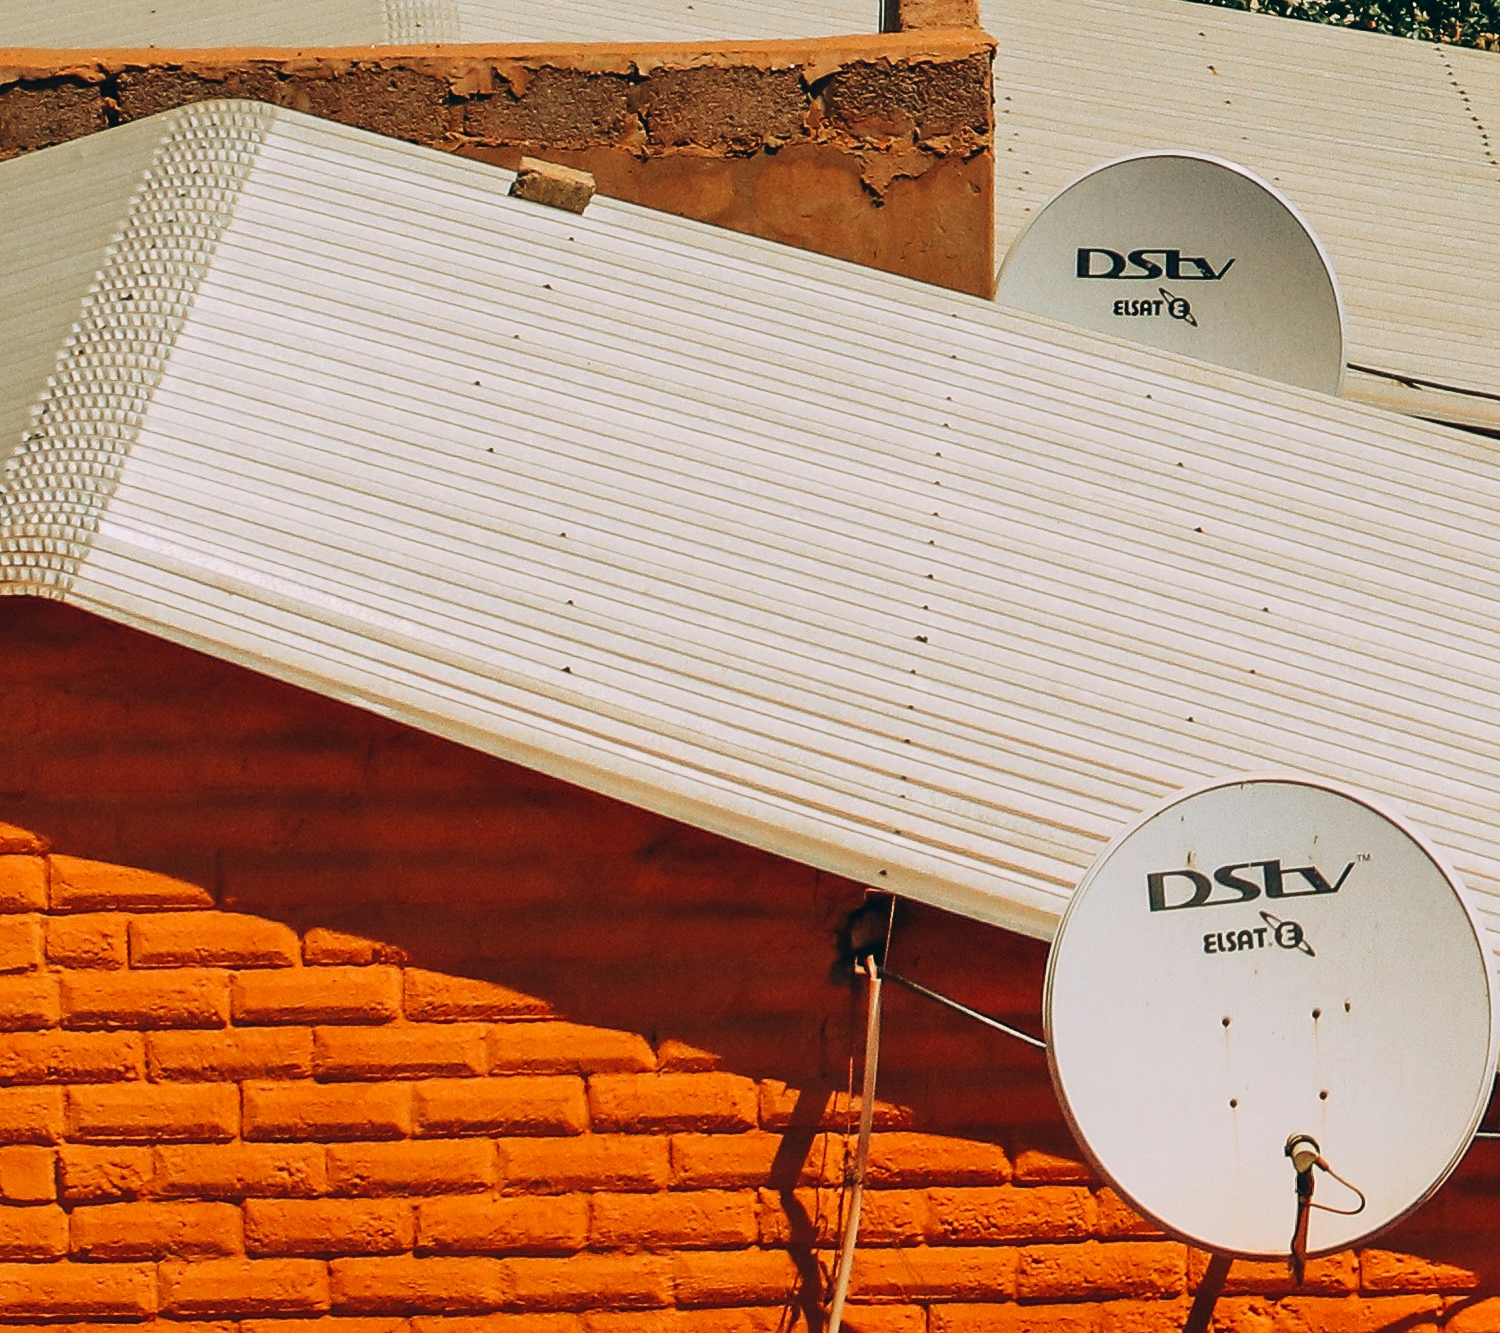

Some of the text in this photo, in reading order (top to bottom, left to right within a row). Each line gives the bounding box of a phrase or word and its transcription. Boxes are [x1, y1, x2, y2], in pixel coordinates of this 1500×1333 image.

[1077, 247, 1236, 281] DStv
[1113, 299, 1164, 317] ELSAT
[1147, 859, 1356, 913] DStv
[1203, 927, 1268, 954] ELSAT
